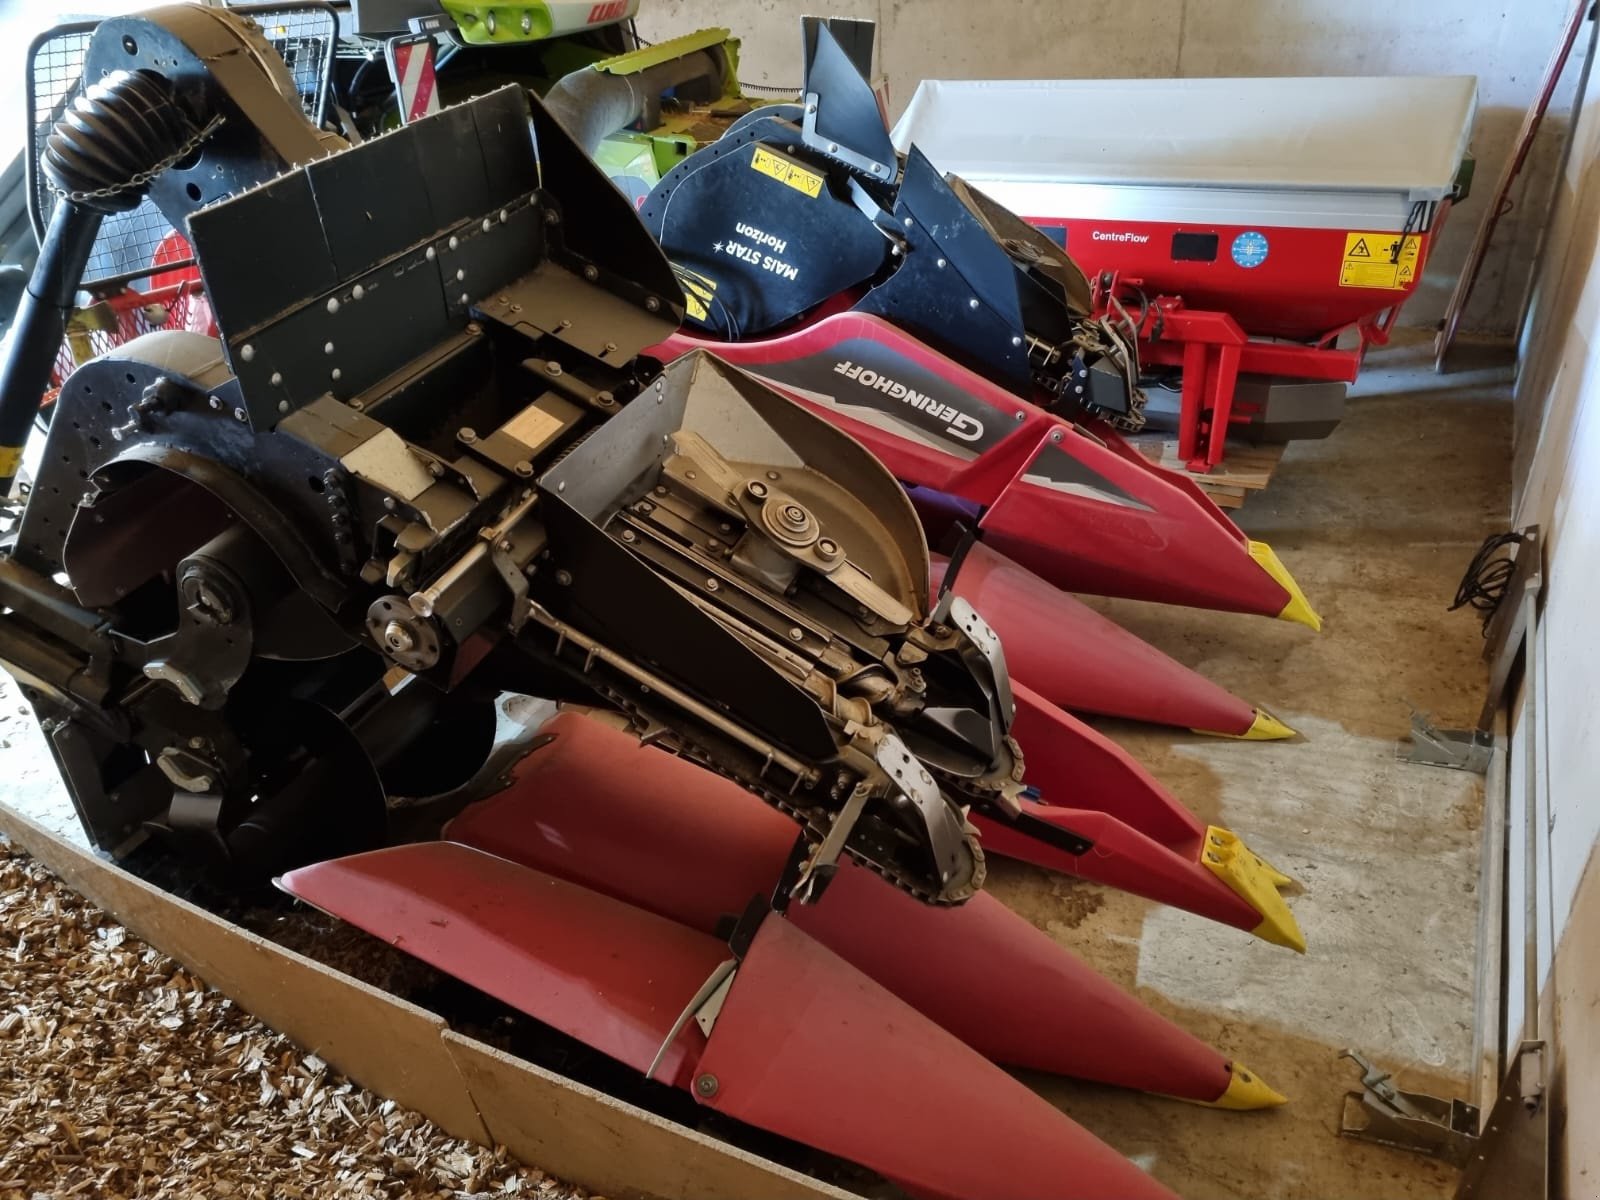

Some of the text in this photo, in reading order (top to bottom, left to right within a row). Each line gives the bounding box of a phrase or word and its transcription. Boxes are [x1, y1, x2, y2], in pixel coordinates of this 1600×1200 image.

[735, 222, 787, 254] Horizon
[1092, 231, 1149, 243] CentreFlow
[725, 240, 799, 280] MAIS STAR
[834, 361, 984, 442] GERINGHOFF
